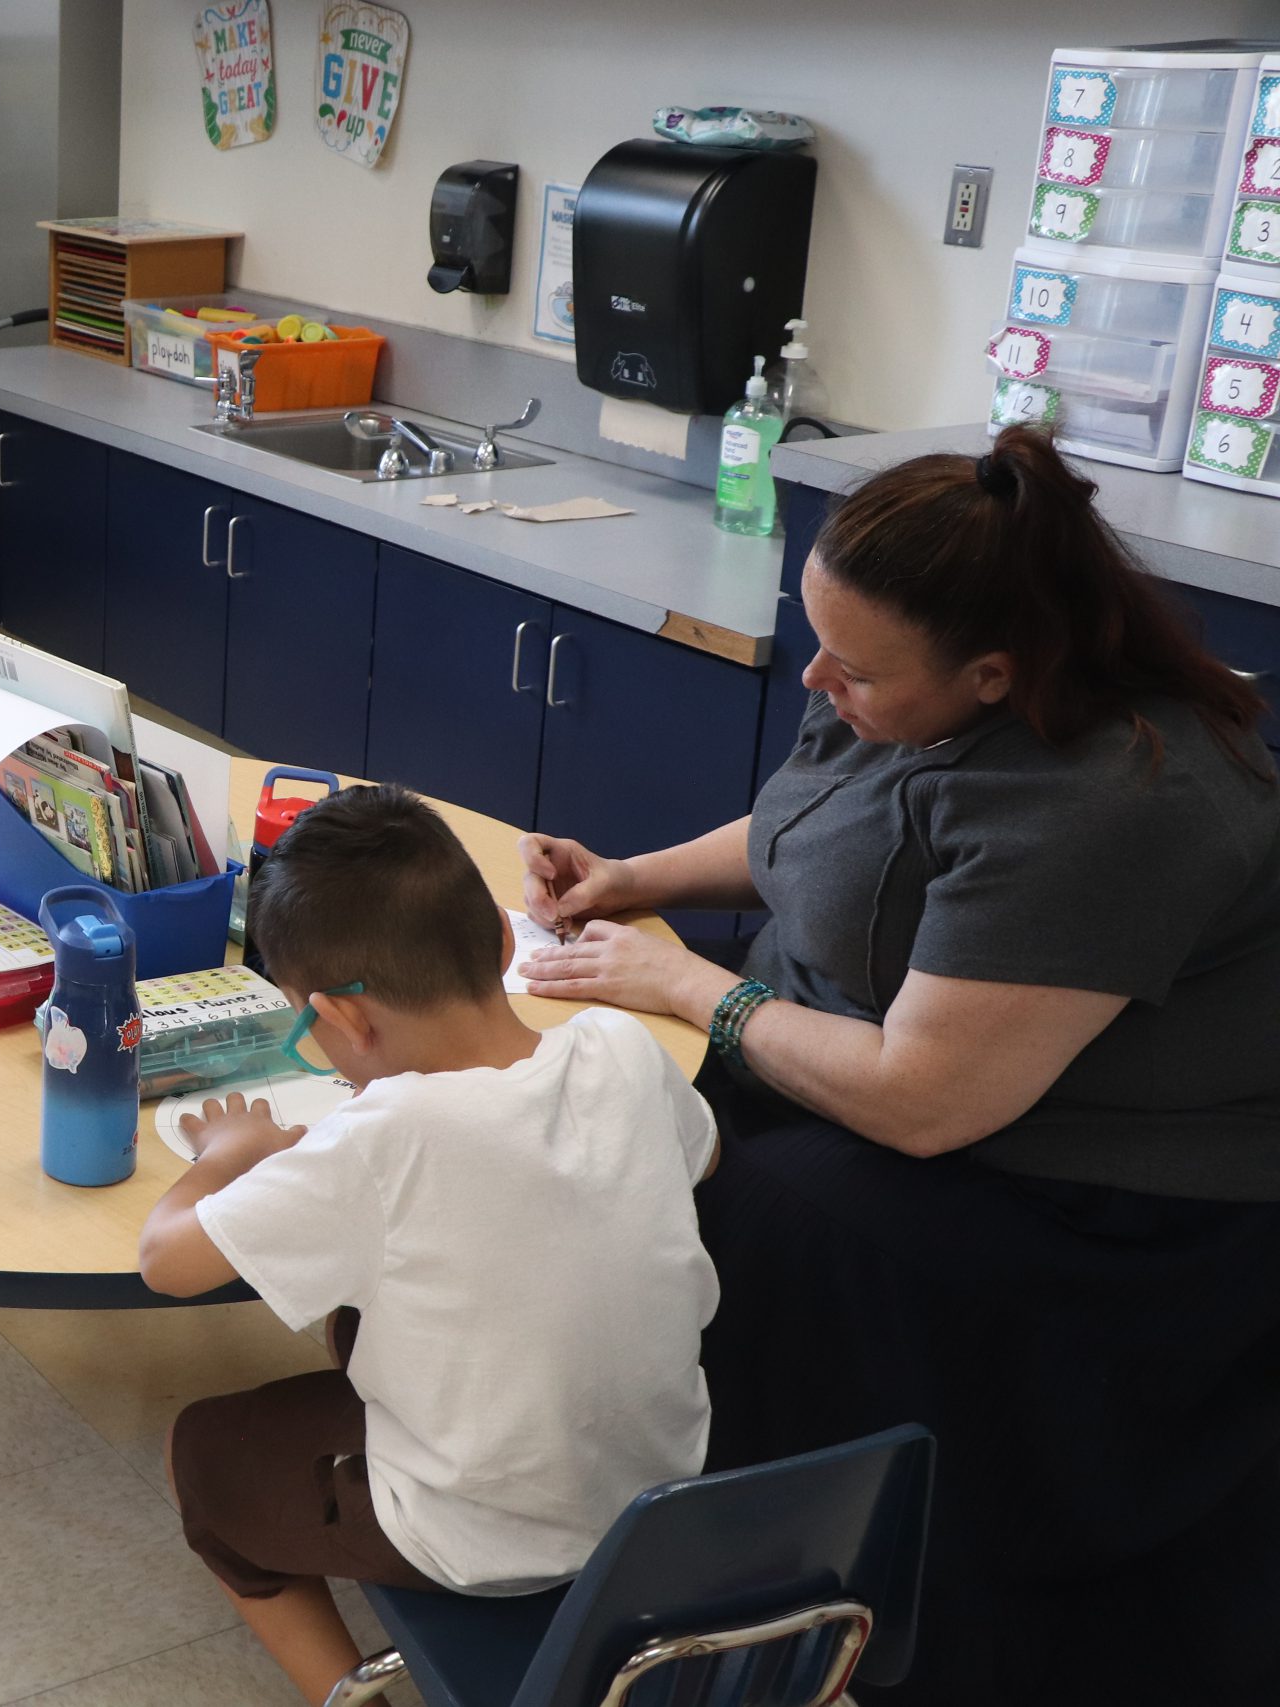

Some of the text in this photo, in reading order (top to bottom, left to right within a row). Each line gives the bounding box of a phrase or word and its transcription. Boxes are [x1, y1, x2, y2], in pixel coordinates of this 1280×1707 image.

[213, 19, 257, 54] MAKE
[349, 31, 386, 55] never
[219, 57, 258, 81] today
[322, 53, 398, 120] GIVE
[219, 82, 263, 115] GREAT
[1073, 89, 1085, 108] 7
[345, 116, 365, 142] up
[1063, 148, 1075, 168] 8
[1055, 203, 1067, 223] 9
[1257, 221, 1270, 242] 3
[1029, 287, 1050, 308] 10
[1240, 313, 1253, 335] 4
[151, 336, 191, 368] play-doh
[1007, 344, 1021, 365] 11
[1228, 379, 1242, 400] 5
[1012, 395, 1034, 415] 12
[1218, 434, 1230, 453] 6
[143, 1024, 153, 1033] 2
[157, 1020, 169, 1029] 3
[173, 1018, 185, 1026] 4
[189, 1016, 202, 1024] 5
[208, 1013, 219, 1021] 6
[240, 1006, 252, 1015] 8
[256, 1003, 268, 1011] 9
[272, 1000, 287, 1009] 10
